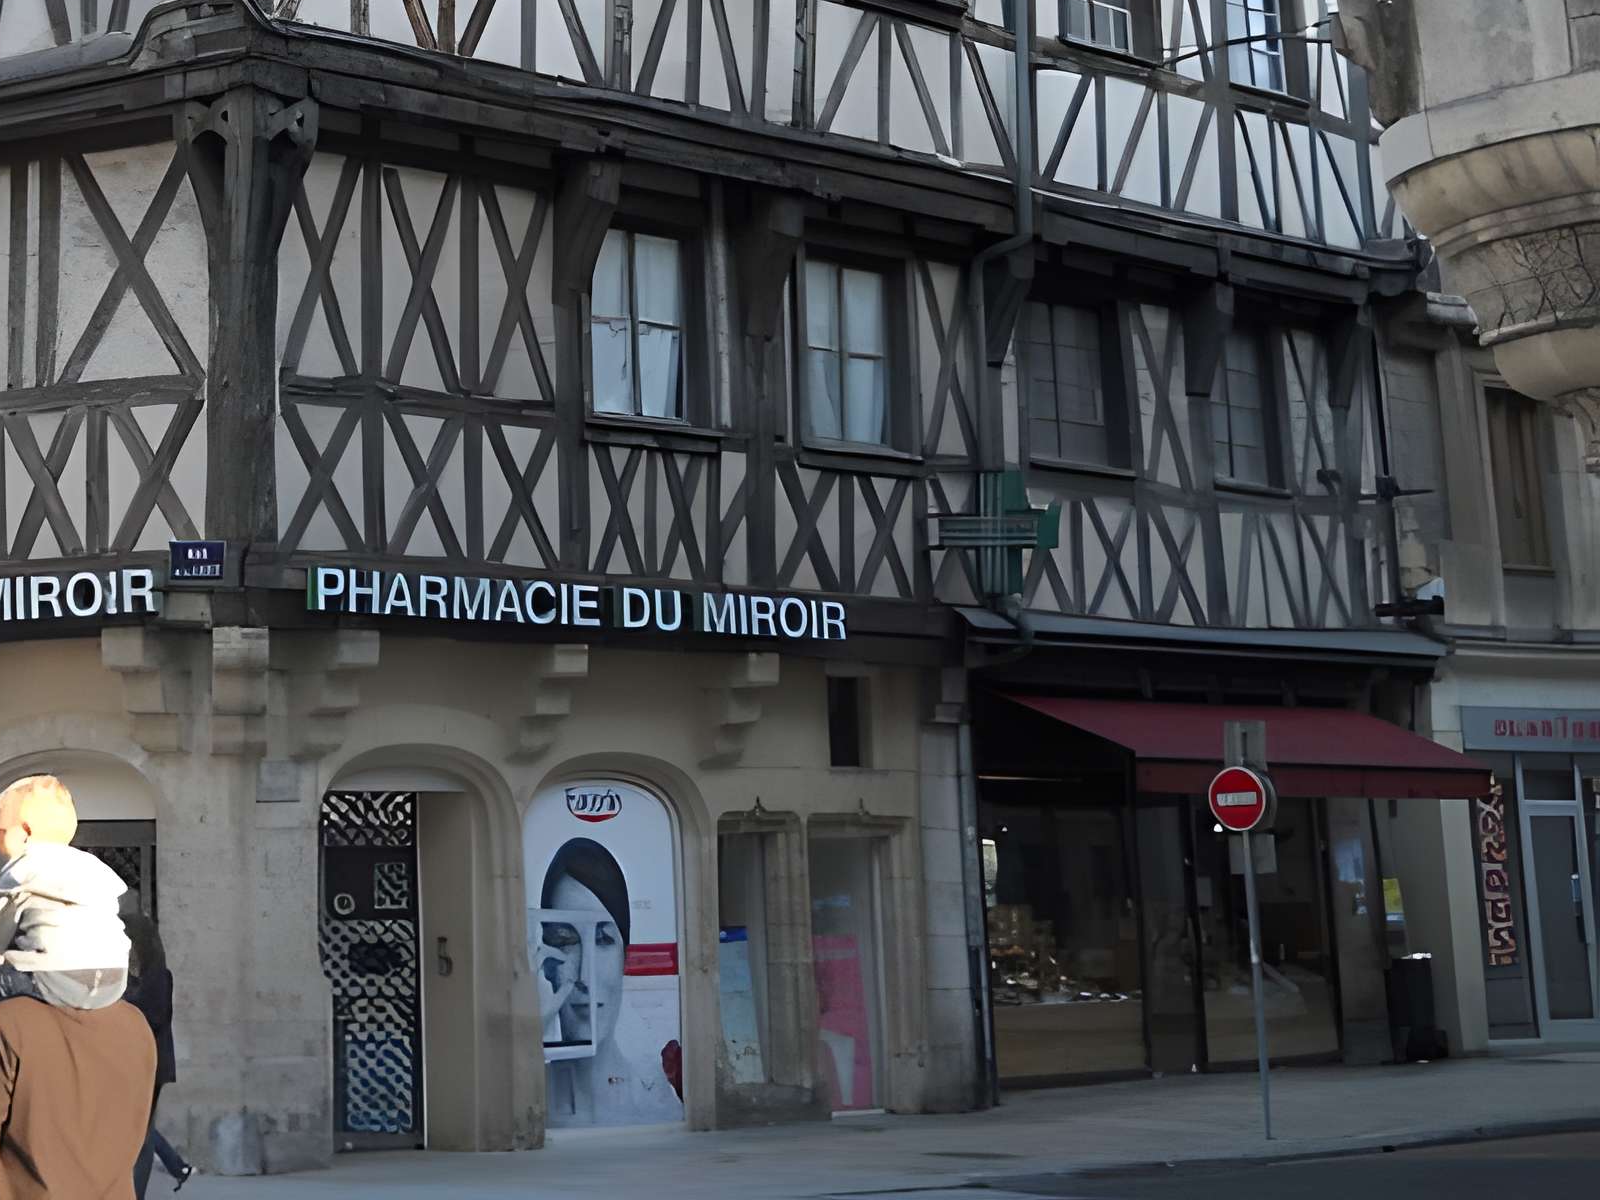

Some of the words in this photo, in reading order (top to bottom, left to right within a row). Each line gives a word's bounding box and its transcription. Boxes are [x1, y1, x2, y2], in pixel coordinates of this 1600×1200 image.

[316, 566, 601, 627] PHARMACIE
[623, 587, 682, 632] DU
[703, 591, 847, 640] MIROIR
